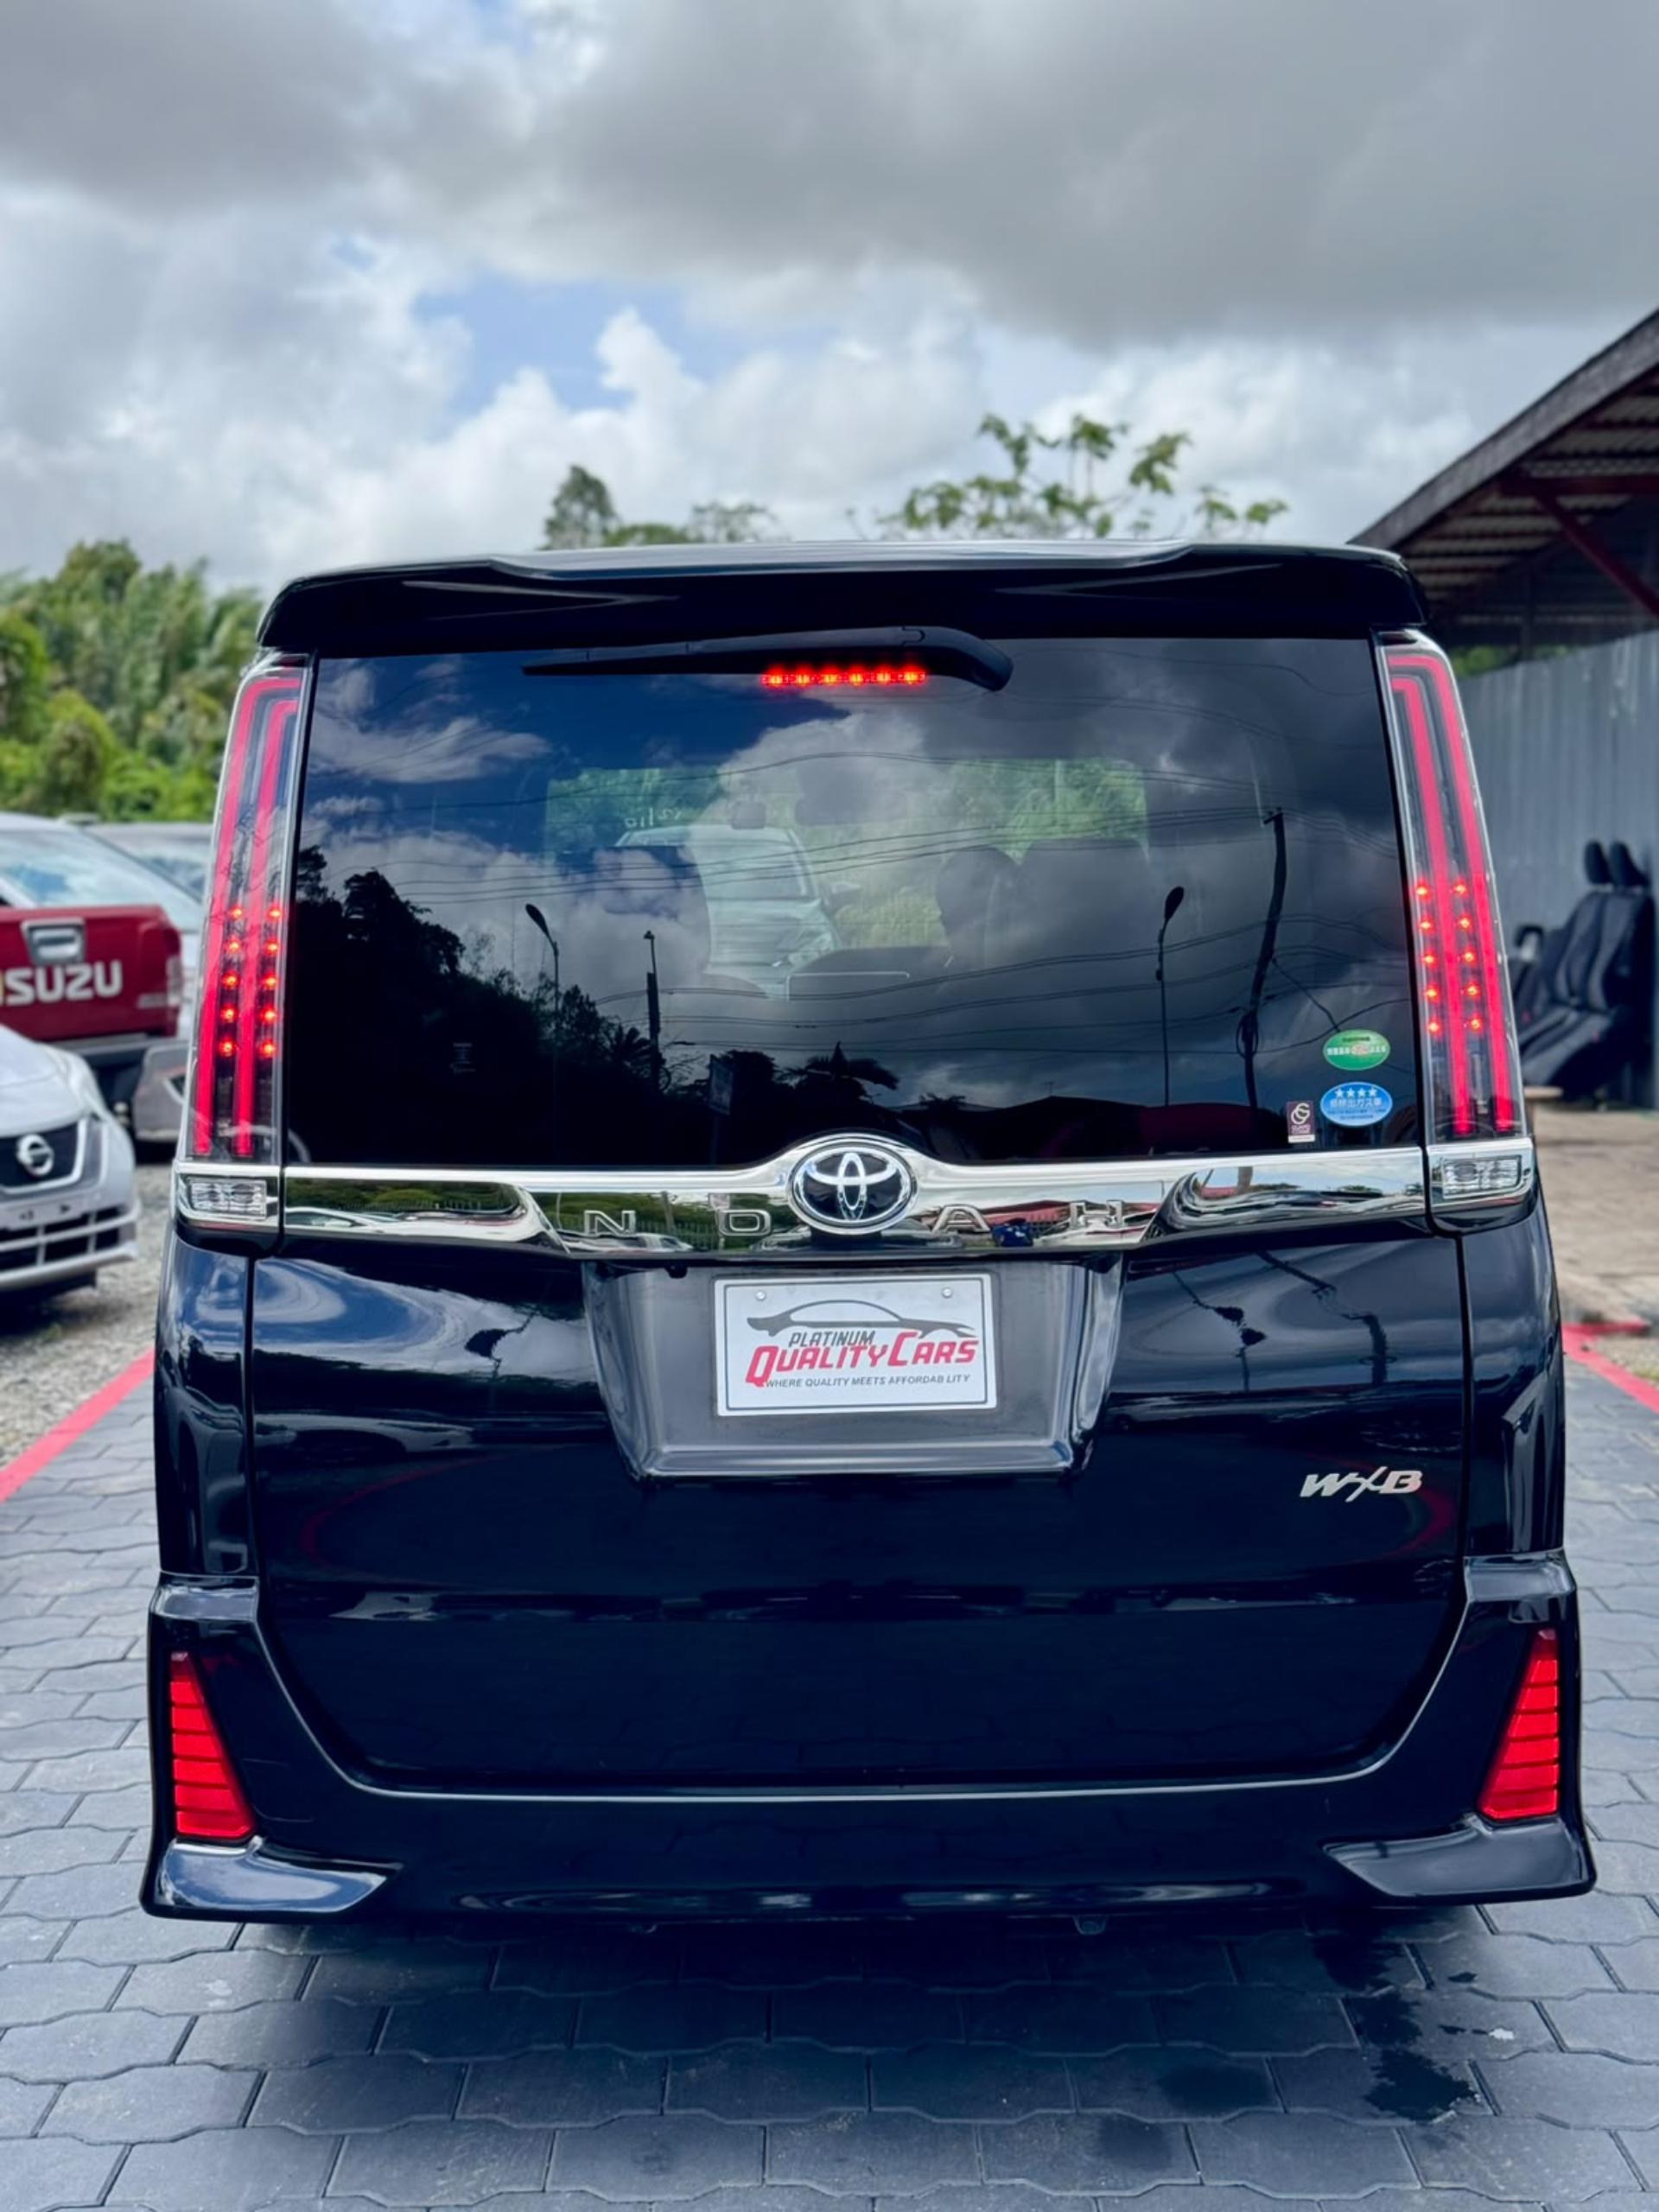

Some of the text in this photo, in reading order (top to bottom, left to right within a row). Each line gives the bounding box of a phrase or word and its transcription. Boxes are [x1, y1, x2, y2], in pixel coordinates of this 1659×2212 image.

[788, 1331, 875, 1347] PLATINUM
[745, 1332, 979, 1388] QUALITY CARS
[766, 1374, 970, 1388] WHERE QUALITY MEETS AFFORDABLITY
[1300, 1466, 1423, 1503] WXB
